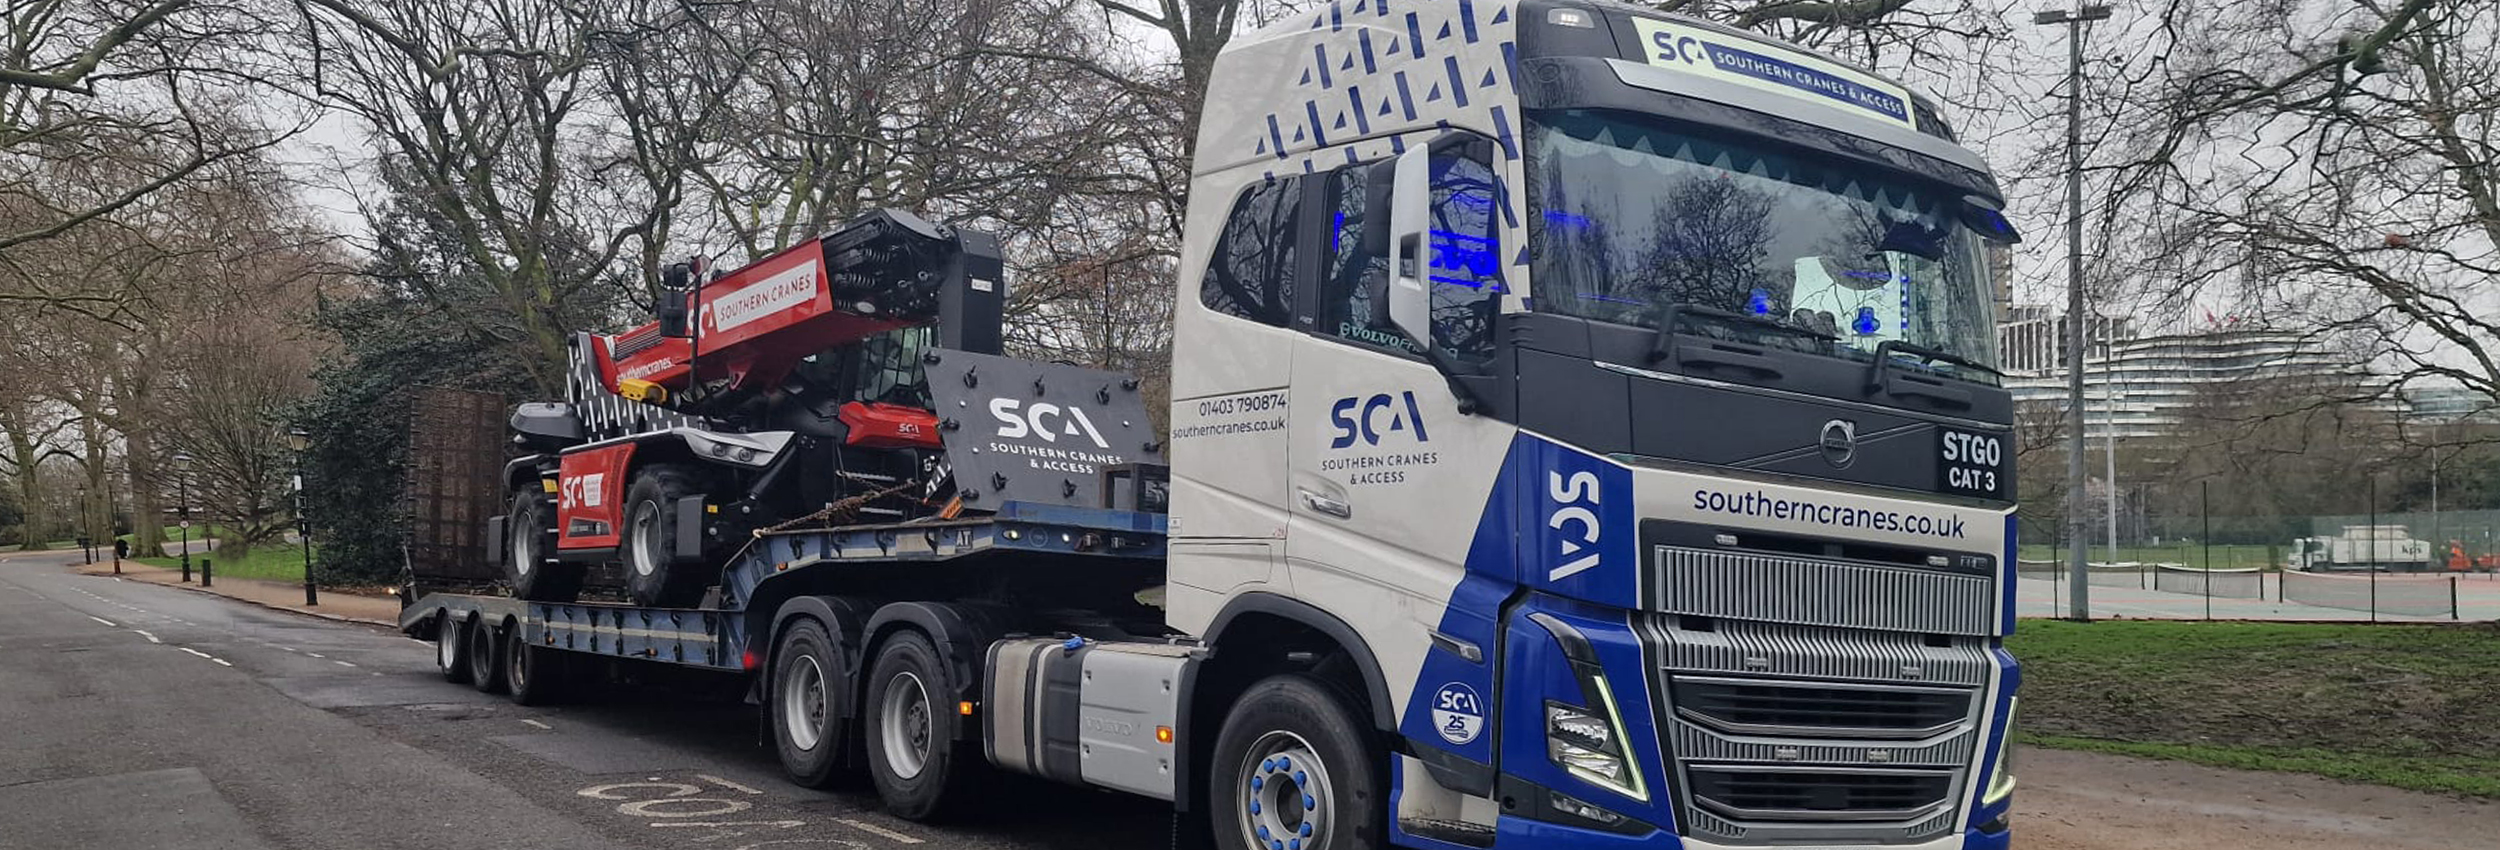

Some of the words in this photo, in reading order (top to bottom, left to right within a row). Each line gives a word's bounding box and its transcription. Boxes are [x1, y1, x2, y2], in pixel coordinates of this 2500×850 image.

[1653, 31, 1712, 64] SCA
[1717, 51, 1792, 80] SOUTHERN
[1796, 72, 1846, 96] CRANES
[1849, 88, 1858, 99] &
[1860, 91, 1903, 115] ACCESS
[720, 293, 769, 321] SOUTHERN
[771, 274, 811, 303] CRANES
[1351, 326, 1398, 347] VOLVO
[1199, 399, 1234, 416] 01403
[1237, 394, 1287, 412] 790874
[989, 398, 1109, 448] SCA
[1173, 416, 1286, 439] southerncranes.co.uk
[1331, 391, 1428, 449] SCA
[990, 442, 1067, 460] SOUTHERN
[1069, 451, 1123, 465] CRANES
[1943, 431, 2001, 467] STGO
[1030, 459, 1039, 468] &
[1043, 460, 1094, 474] ACCESS
[1321, 456, 1384, 471] SOUTHERN
[1387, 452, 1438, 467] CRANES
[1350, 474, 1357, 485] &
[1361, 471, 1405, 484] ACCESS
[1949, 466, 1981, 490] CAT
[1985, 471, 1996, 491] 3
[1694, 489, 1966, 539] southerncranes.co.uk
[1549, 471, 1600, 582] SCA
[1440, 690, 1478, 713] SCA
[1449, 714, 1465, 729] 25
